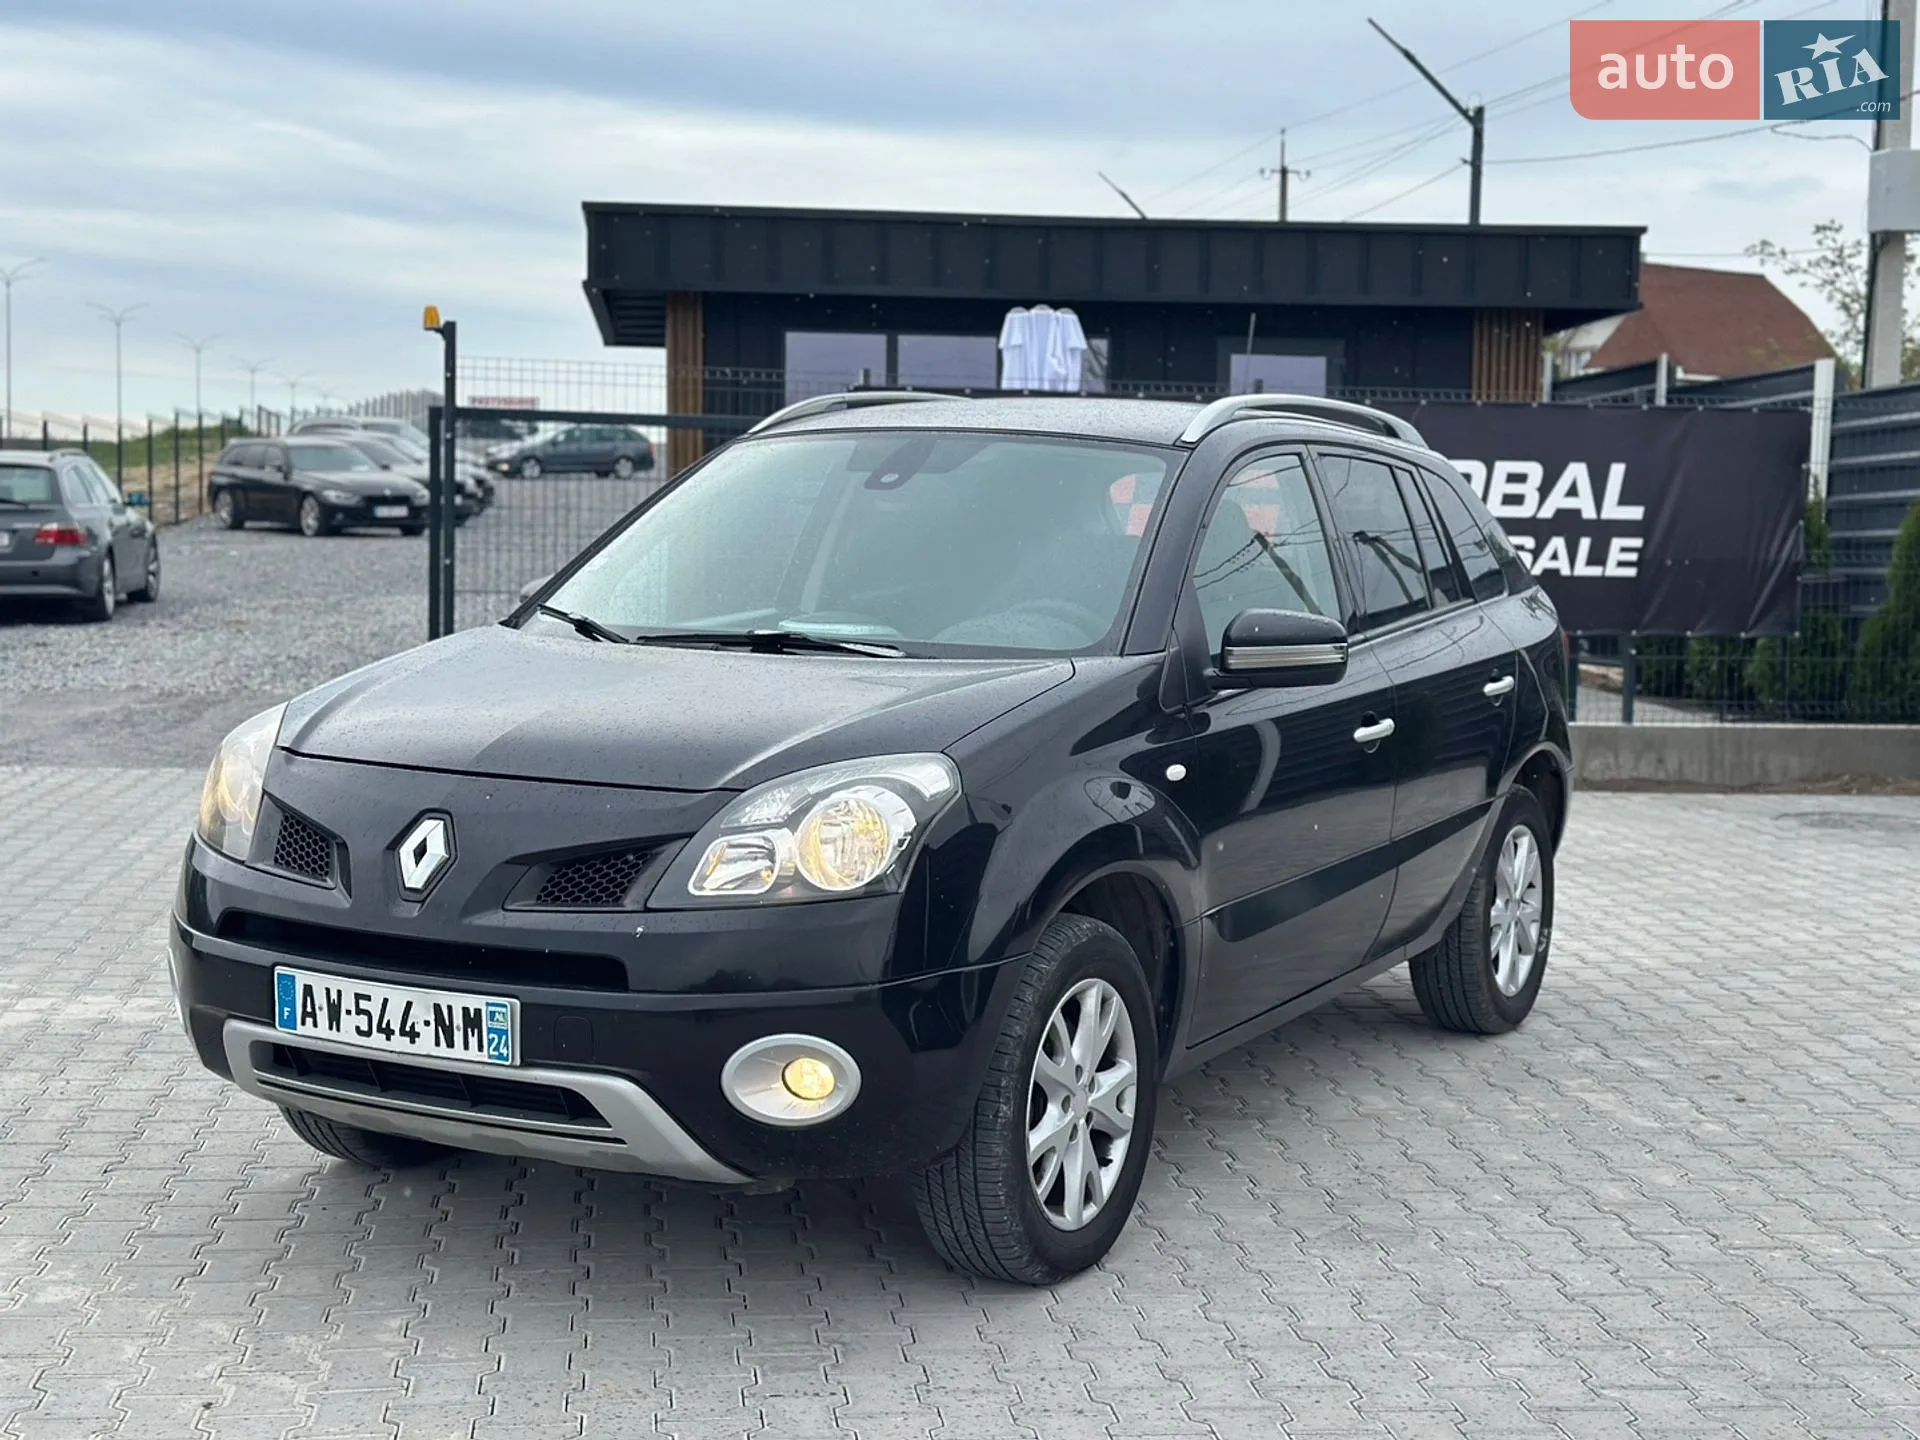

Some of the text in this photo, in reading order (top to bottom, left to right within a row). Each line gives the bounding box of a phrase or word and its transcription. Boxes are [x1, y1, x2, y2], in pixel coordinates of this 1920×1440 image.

[283, 1007, 291, 1020] F
[300, 983, 485, 1053] AW-544-NM
[488, 1033, 508, 1057] 24
